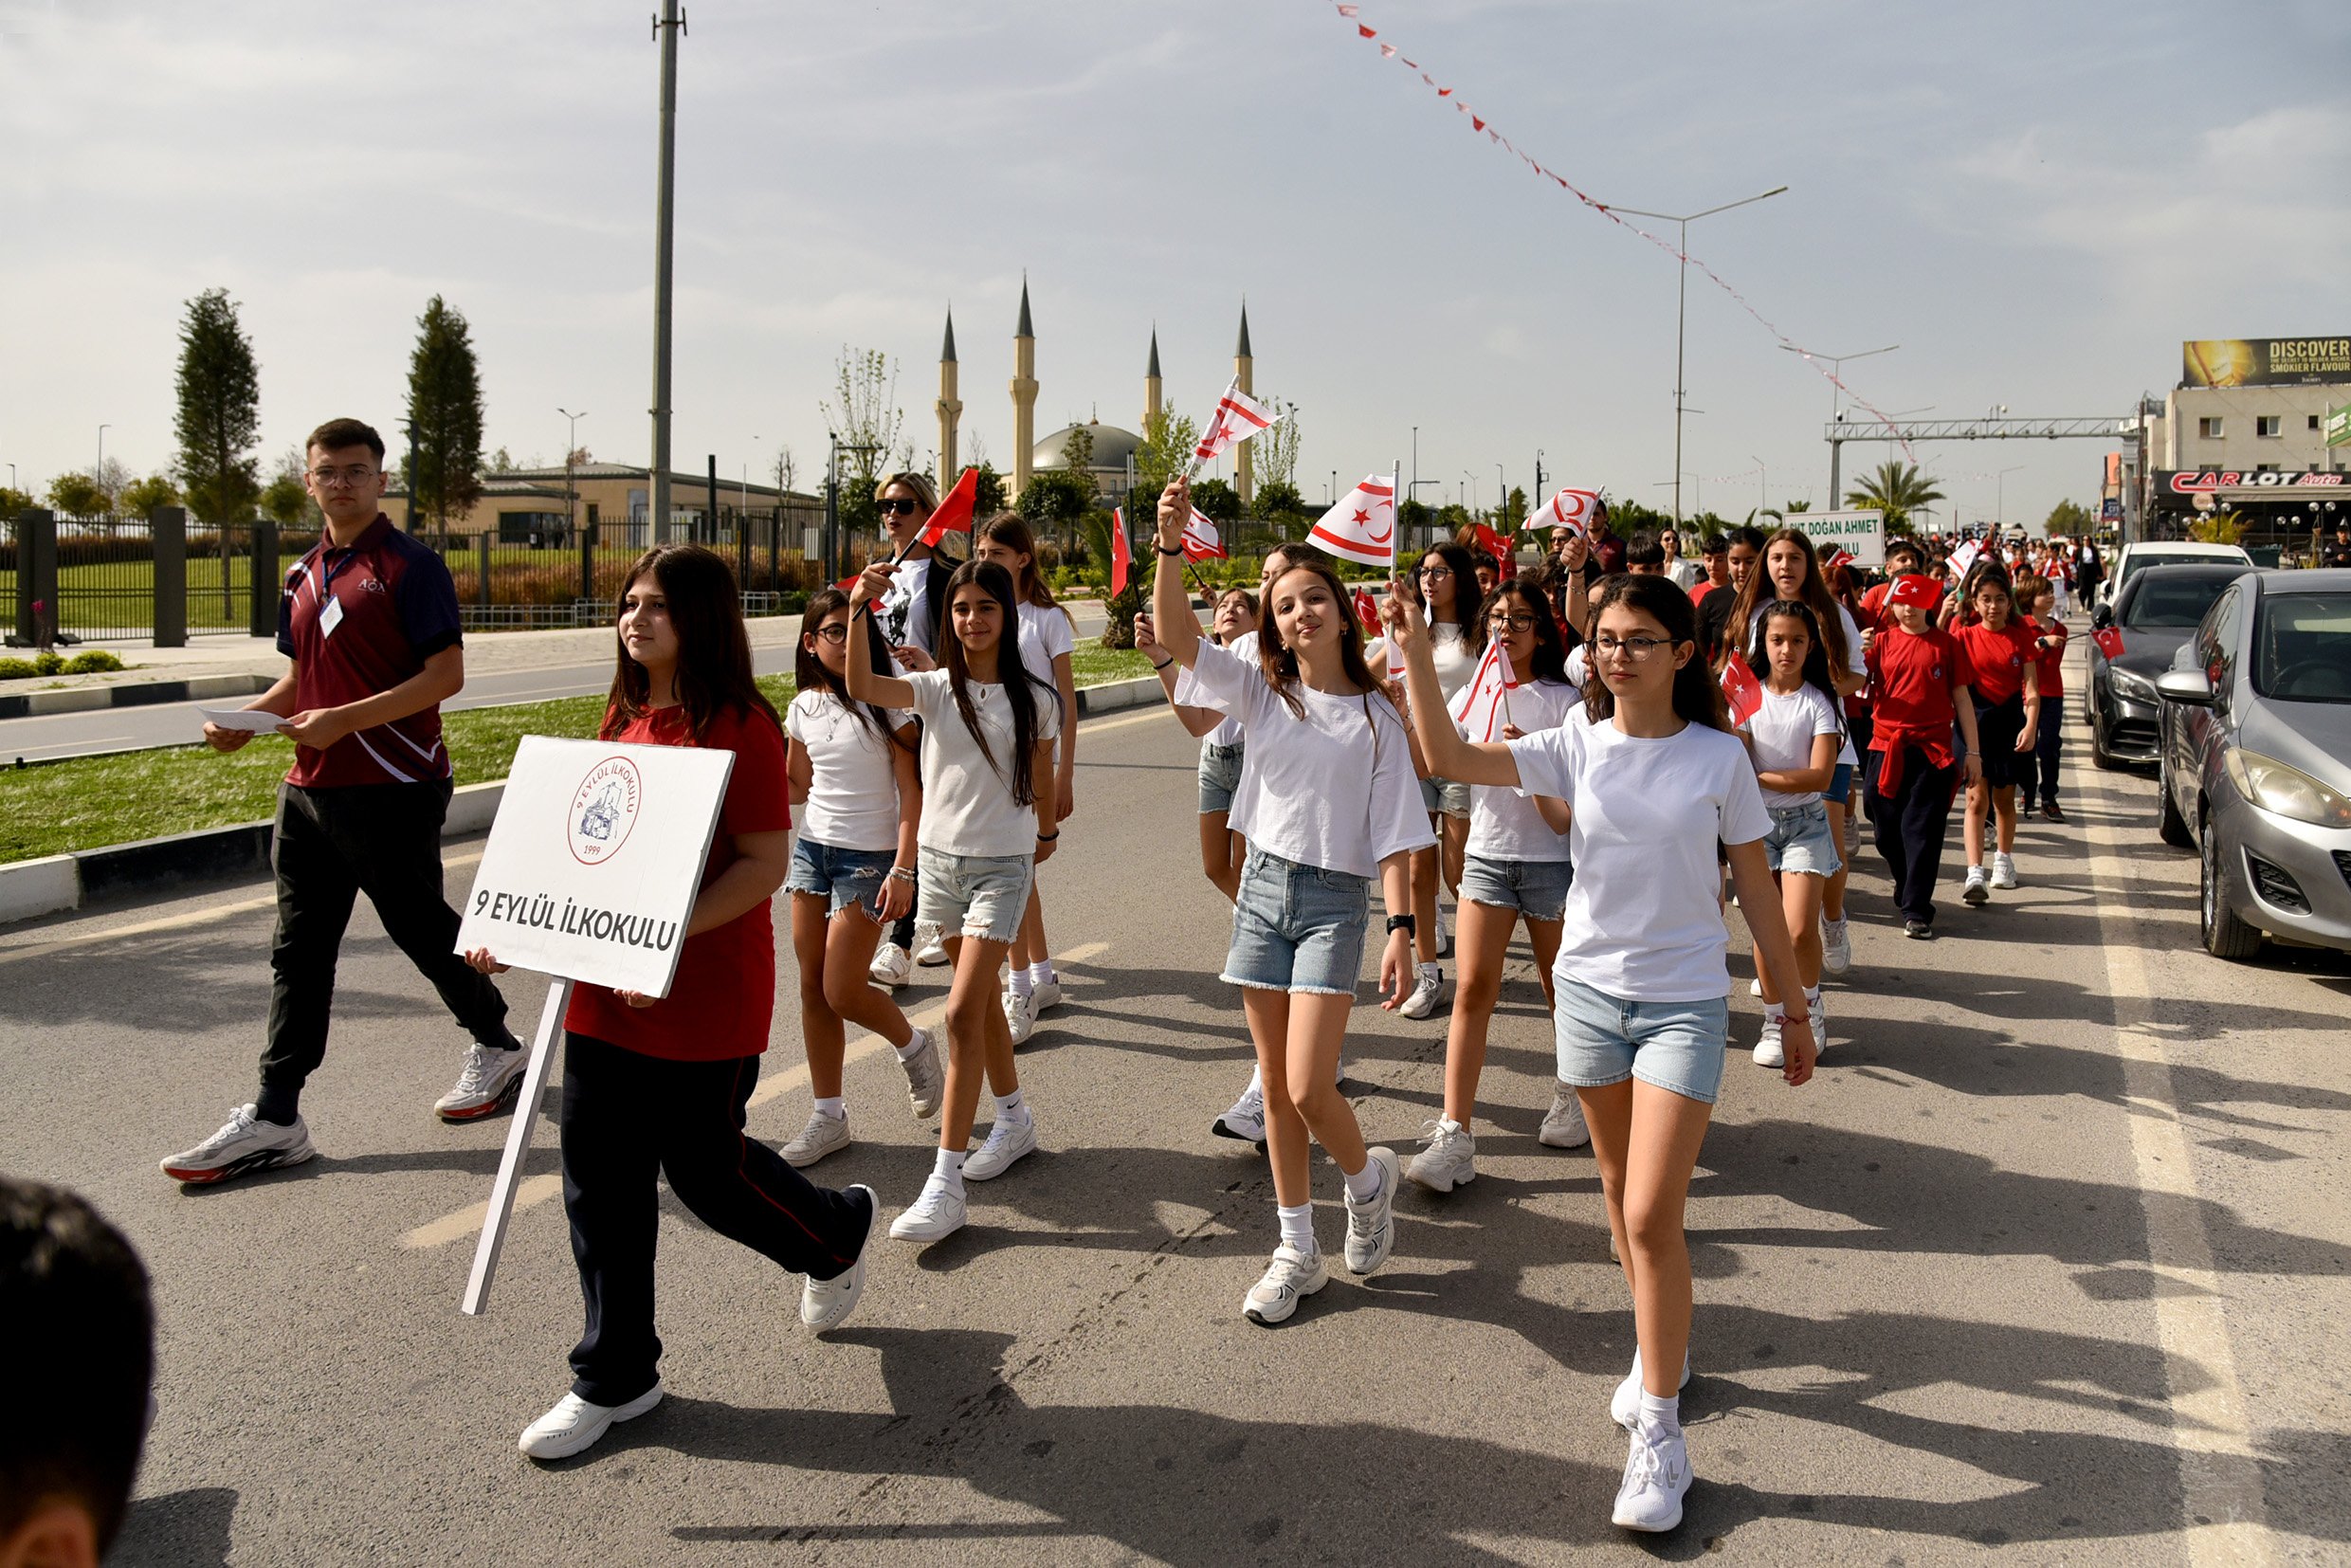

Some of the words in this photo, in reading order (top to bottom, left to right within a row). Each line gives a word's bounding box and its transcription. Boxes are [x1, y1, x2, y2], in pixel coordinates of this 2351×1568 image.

[2270, 340, 2350, 357] DISCOVER
[2269, 362, 2309, 373] SMOKIER
[2310, 361, 2351, 372] FLAVOUR
[1809, 518, 1842, 536] DOĞAN
[1845, 519, 1878, 535] AHMET
[576, 801, 584, 810] 9
[581, 766, 609, 798] EYLÜL
[611, 762, 636, 813] İLKOKULU
[583, 845, 601, 856] 1999
[474, 889, 489, 916] 9
[490, 891, 556, 930] EYLÜL
[559, 896, 677, 951] İLKOKULU
